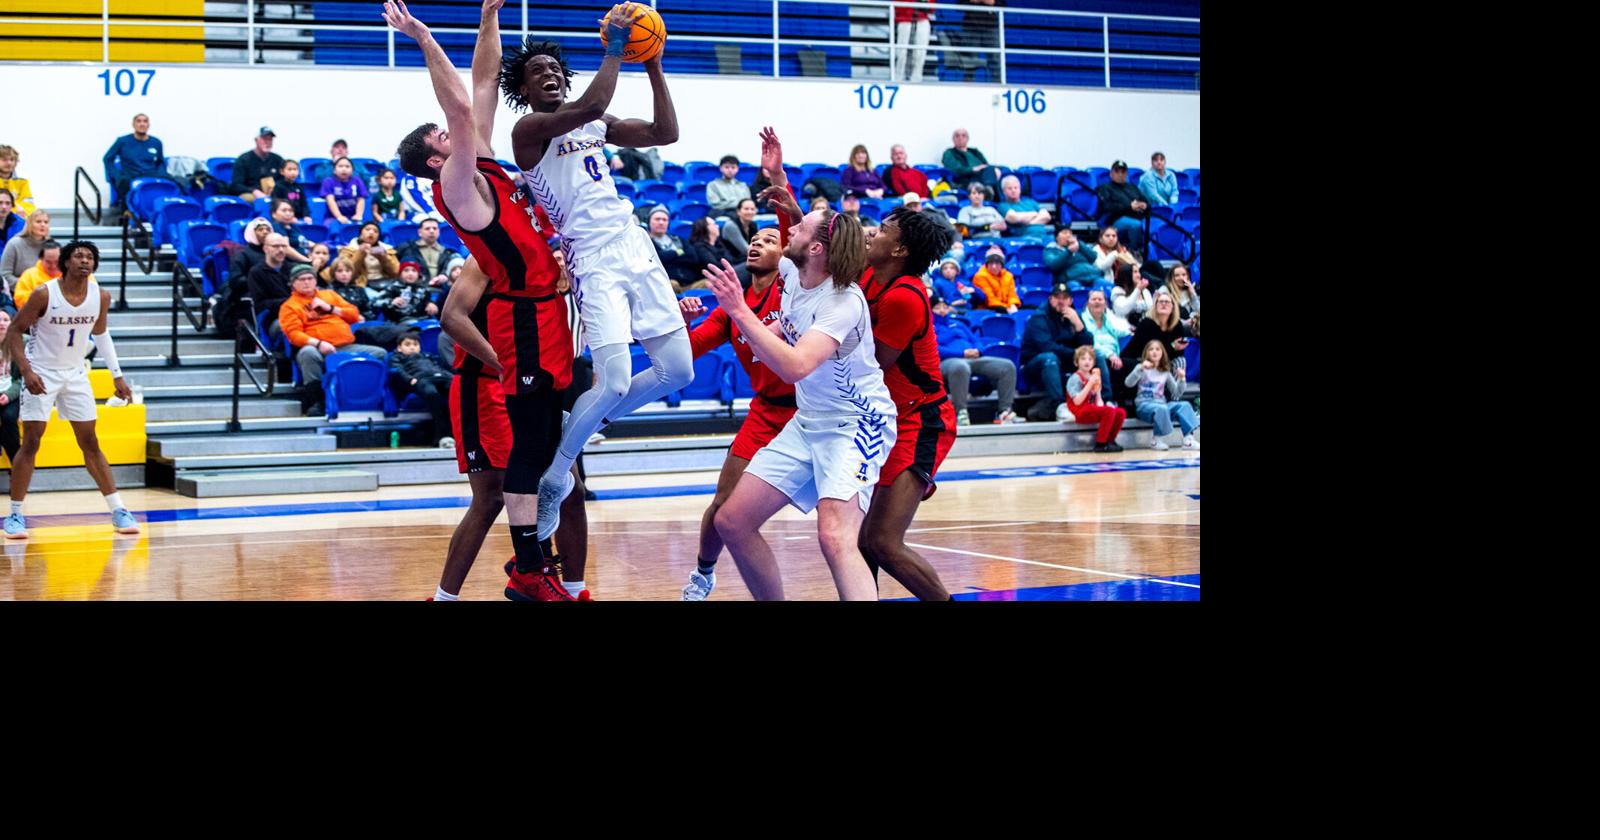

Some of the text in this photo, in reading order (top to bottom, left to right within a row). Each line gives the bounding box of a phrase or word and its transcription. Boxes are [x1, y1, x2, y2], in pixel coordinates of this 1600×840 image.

[98, 69, 156, 96] 107
[853, 84, 900, 110] 107
[1002, 89, 1047, 114] 106
[583, 154, 603, 182] 0
[49, 315, 95, 325] ALASKA
[66, 328, 76, 347] 1
[522, 375, 535, 385] W
